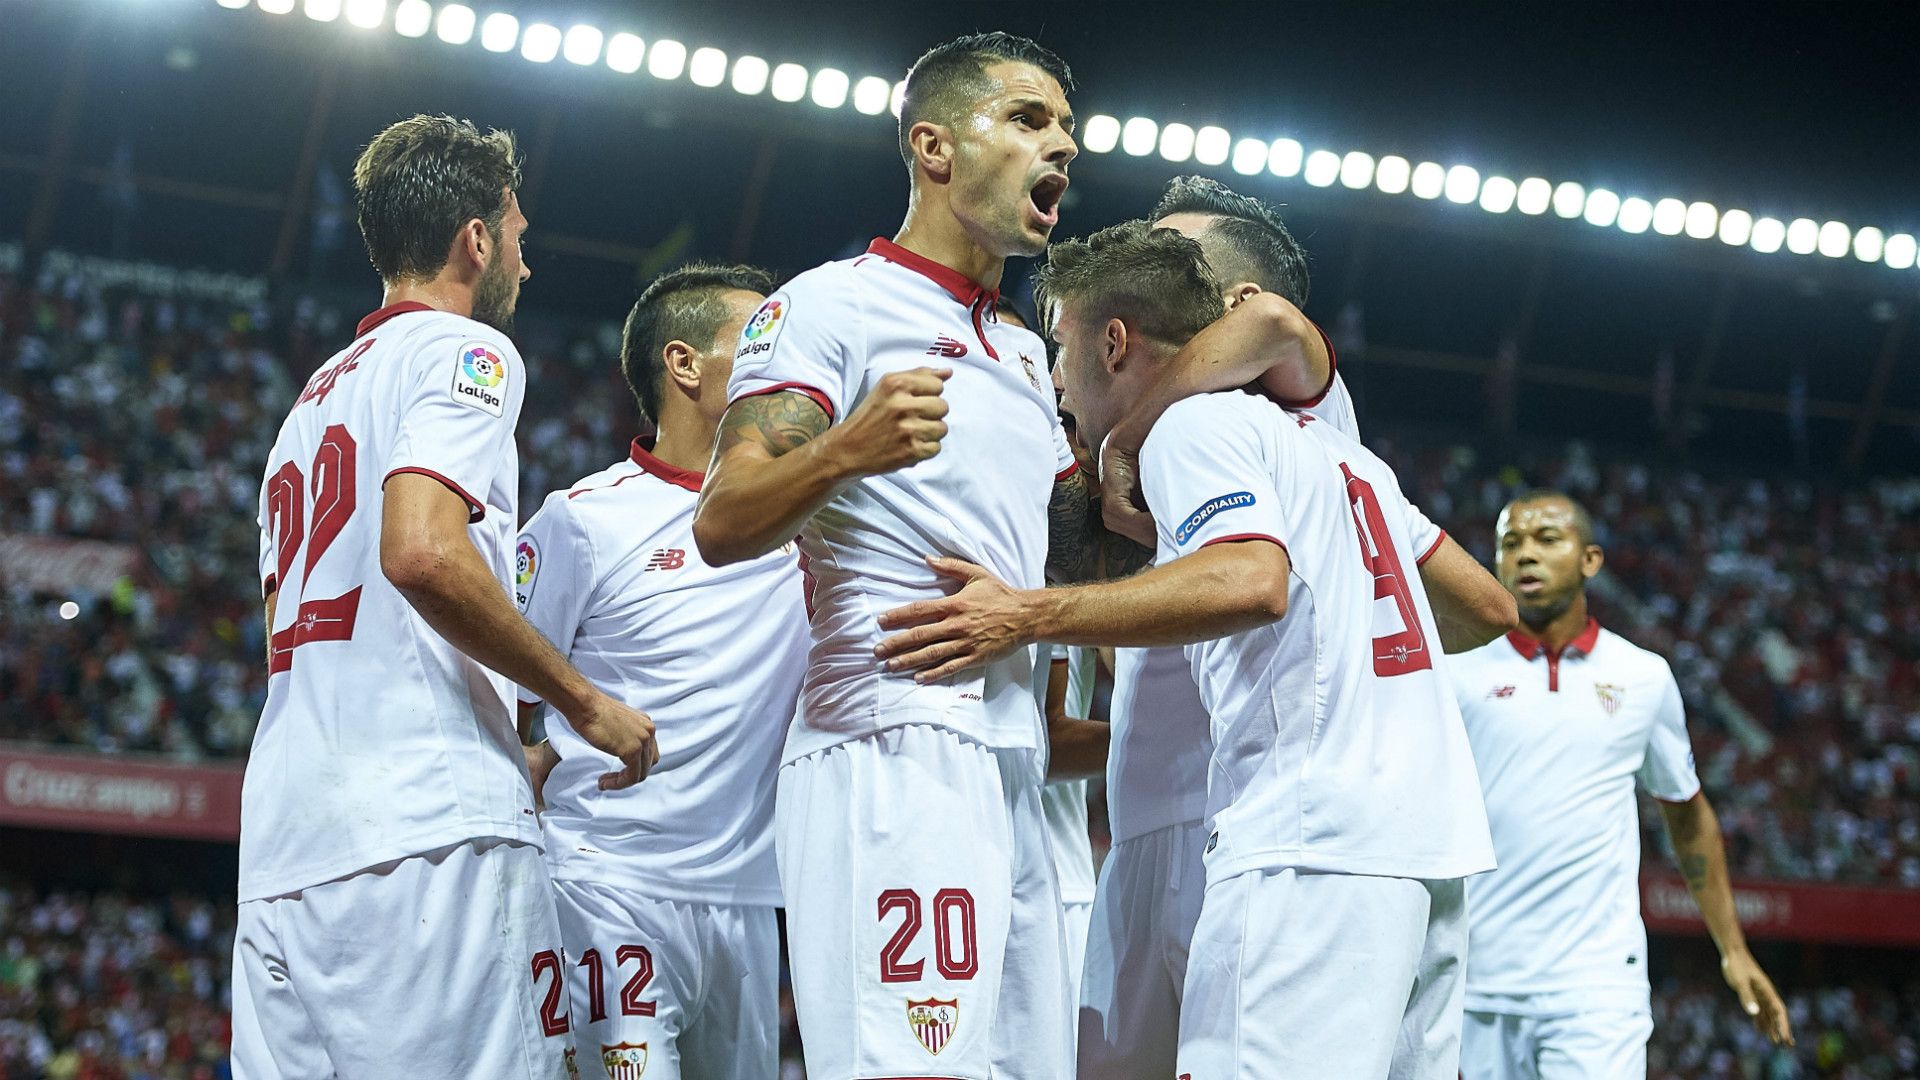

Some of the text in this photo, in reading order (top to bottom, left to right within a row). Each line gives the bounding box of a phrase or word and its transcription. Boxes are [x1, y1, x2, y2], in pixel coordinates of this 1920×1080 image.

[457, 382, 500, 407] LaLiga
[267, 423, 363, 678] 22
[1184, 494, 1252, 534] CORDIALITY
[1339, 461, 1433, 677] 9
[876, 887, 979, 984] 20
[531, 946, 575, 1038] 2
[577, 944, 657, 1024] 12
